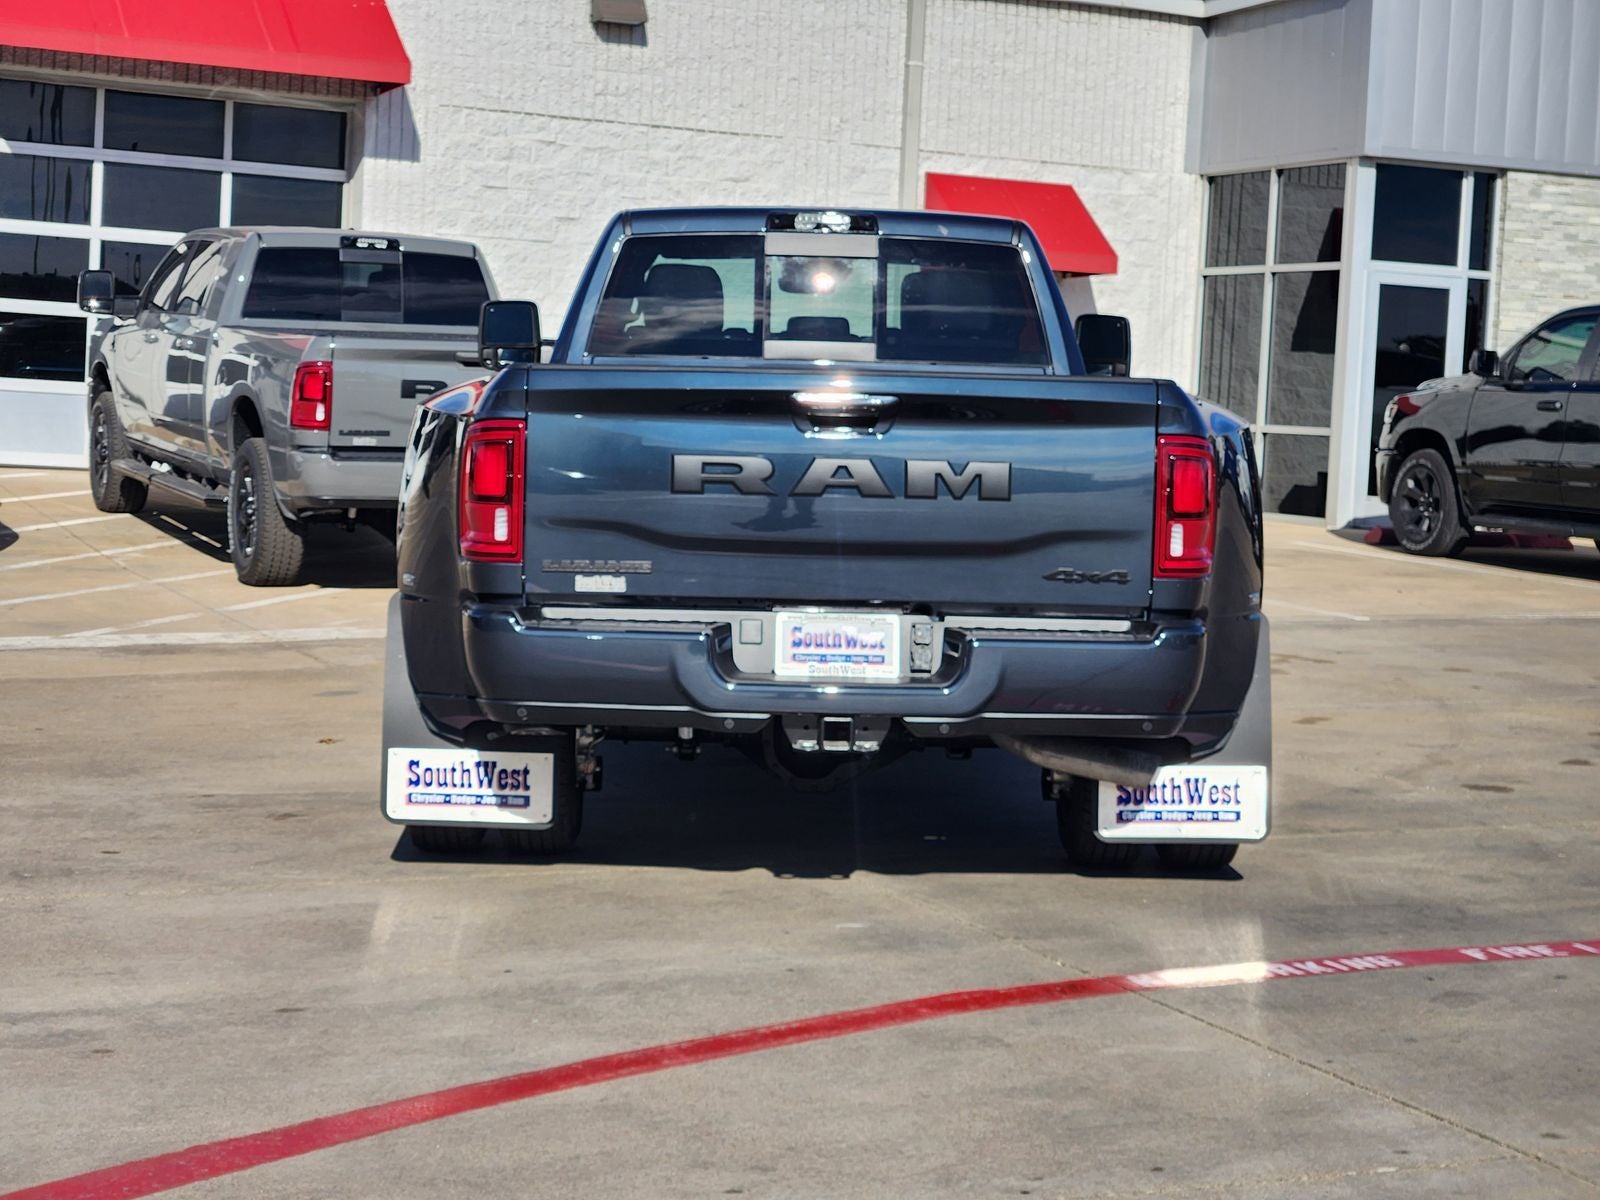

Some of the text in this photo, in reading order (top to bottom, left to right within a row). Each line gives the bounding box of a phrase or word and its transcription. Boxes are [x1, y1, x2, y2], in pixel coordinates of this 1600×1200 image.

[671, 454, 1012, 502] RAM
[808, 664, 867, 675] SouthWest
[407, 759, 531, 792] SouthWest
[1116, 777, 1241, 807] SouthWest
